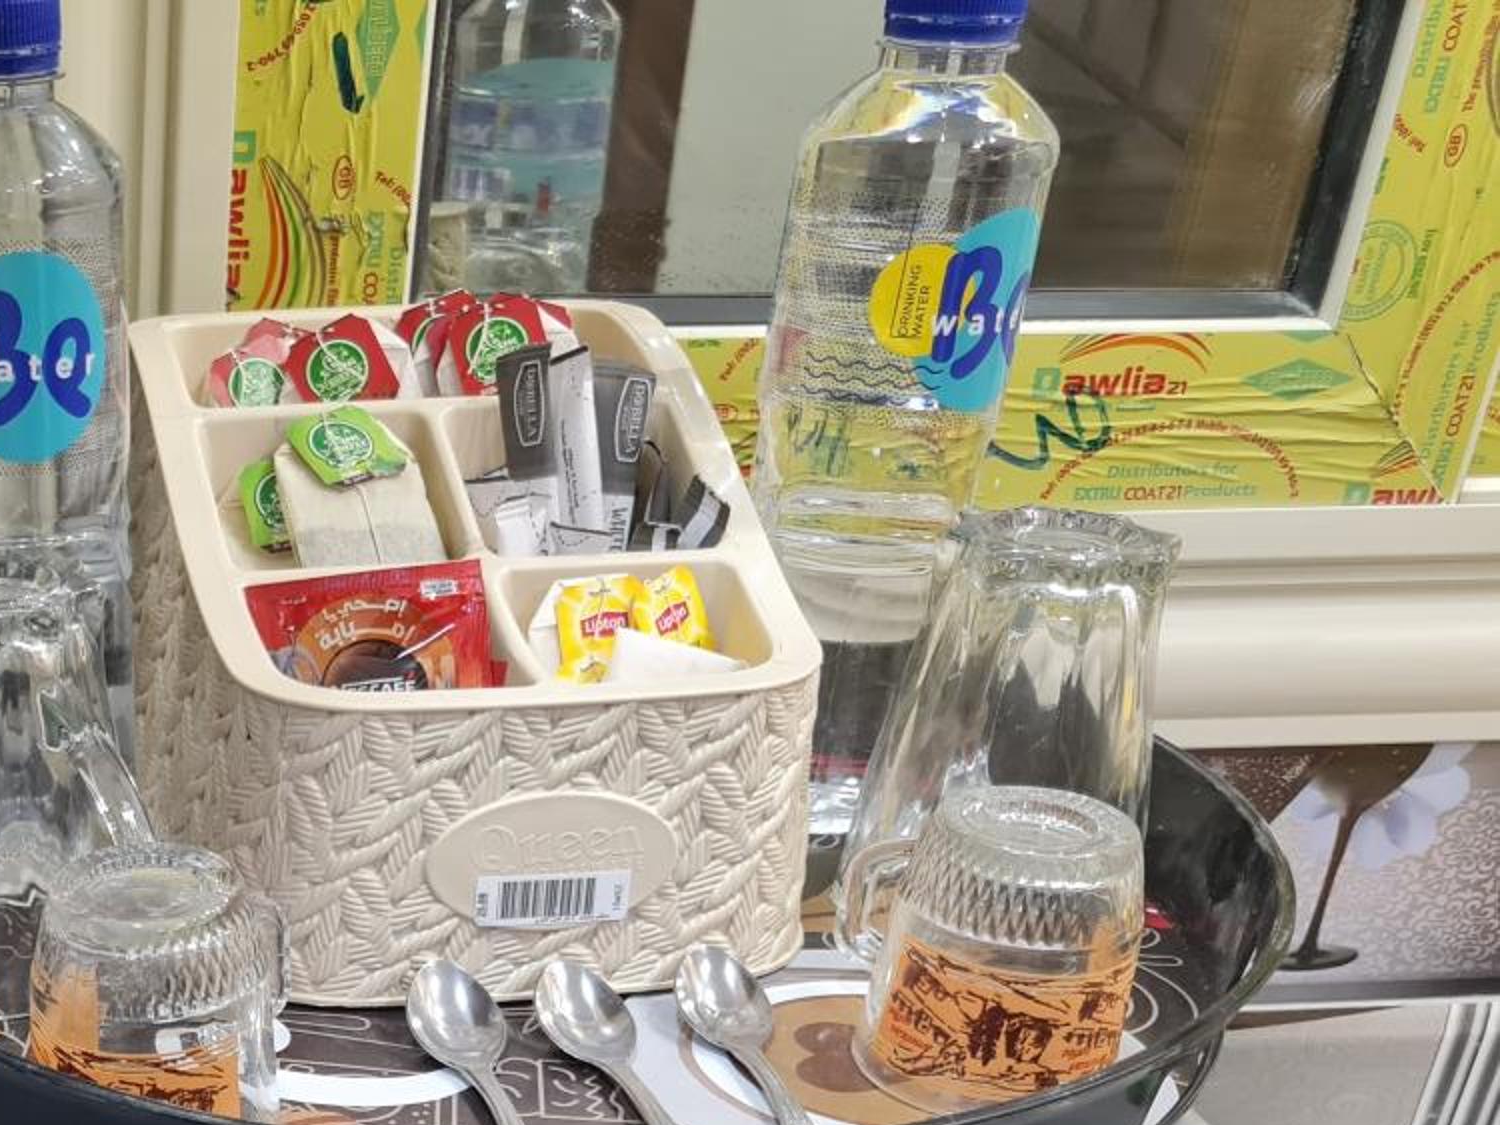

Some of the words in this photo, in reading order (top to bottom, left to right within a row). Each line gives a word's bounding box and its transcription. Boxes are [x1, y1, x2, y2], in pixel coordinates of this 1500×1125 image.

[898, 263, 922, 337] DRINKING
[912, 284, 931, 337] WATER
[1184, 482, 1258, 500] Products
[658, 604, 690, 631] Lipton
